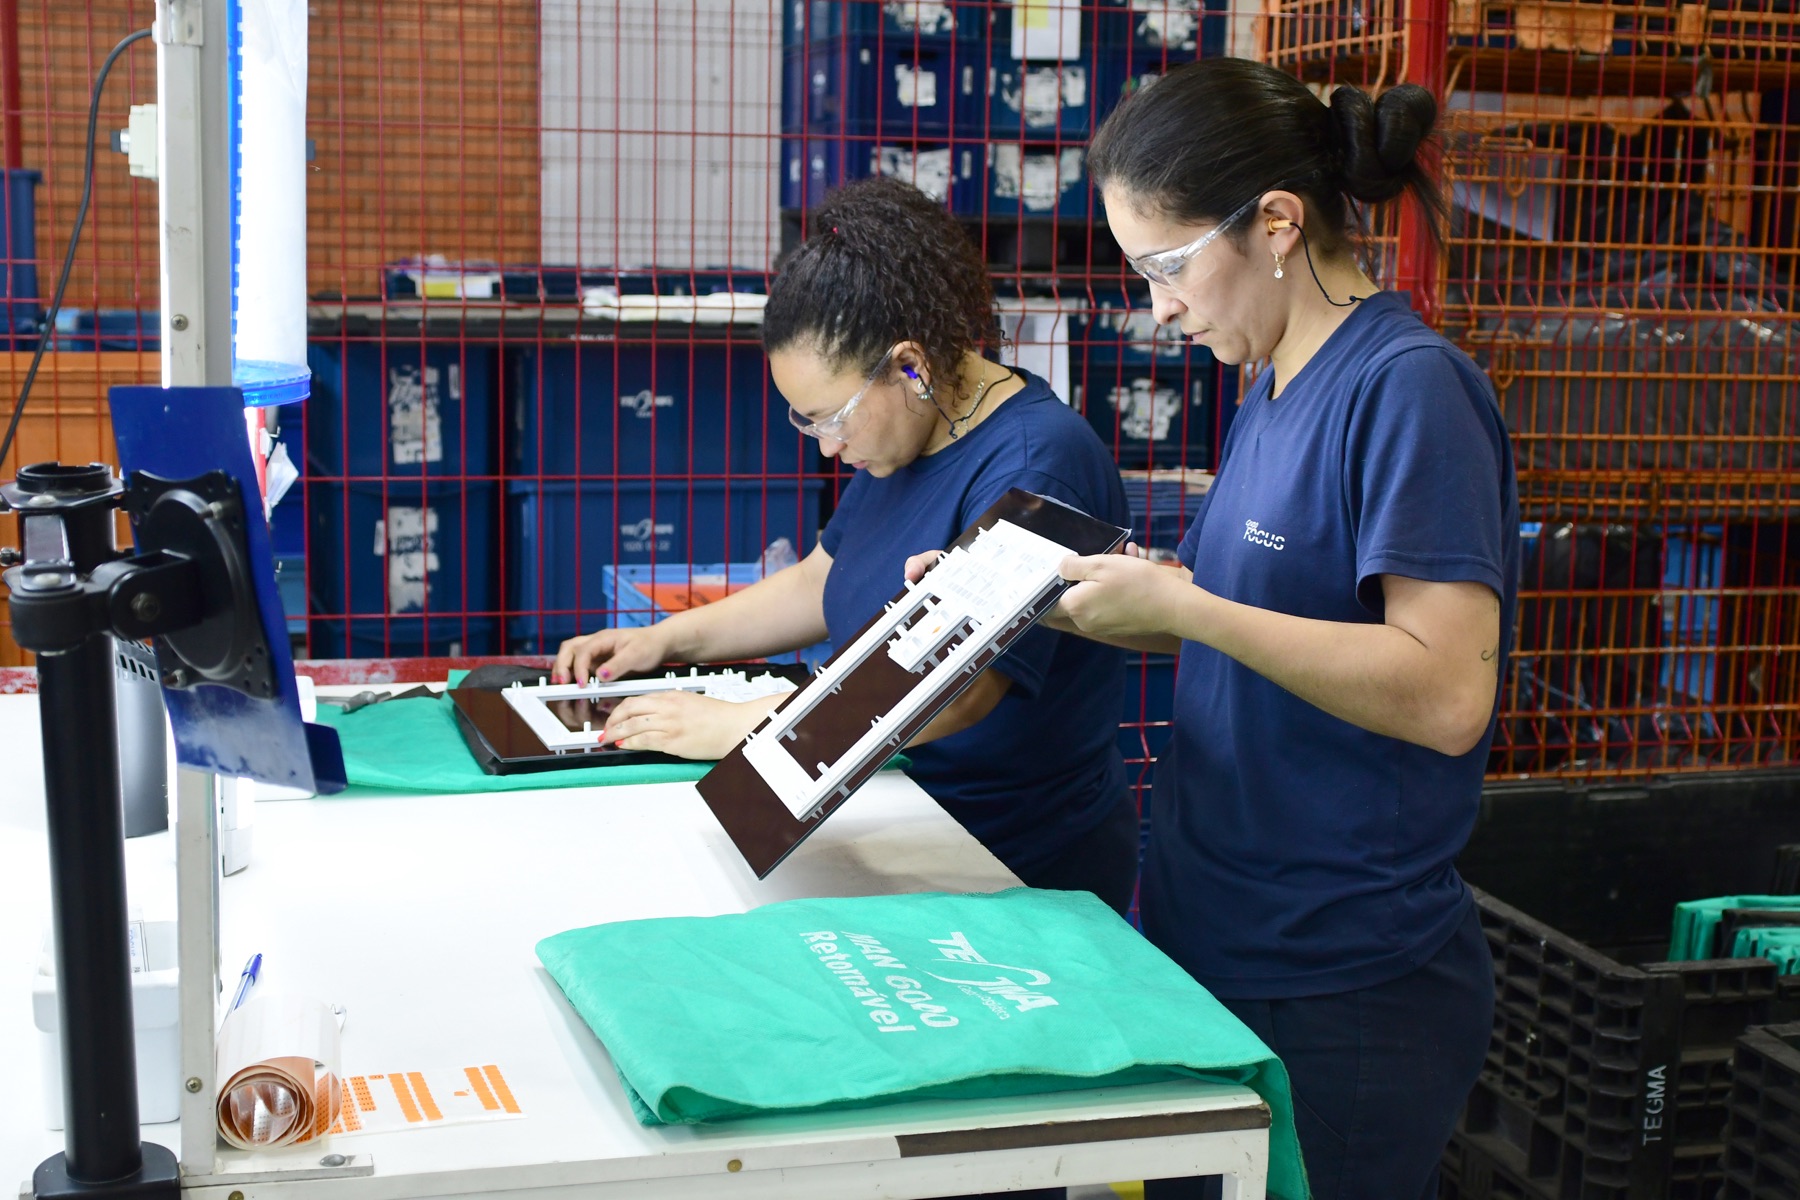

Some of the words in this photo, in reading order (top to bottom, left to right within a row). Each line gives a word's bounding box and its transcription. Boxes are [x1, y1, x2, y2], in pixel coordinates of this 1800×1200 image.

[1243, 526, 1286, 551] FOCUS
[840, 930, 907, 969] MAN
[799, 930, 917, 1033] Retornável
[1642, 1064, 1667, 1147] TEGMA
